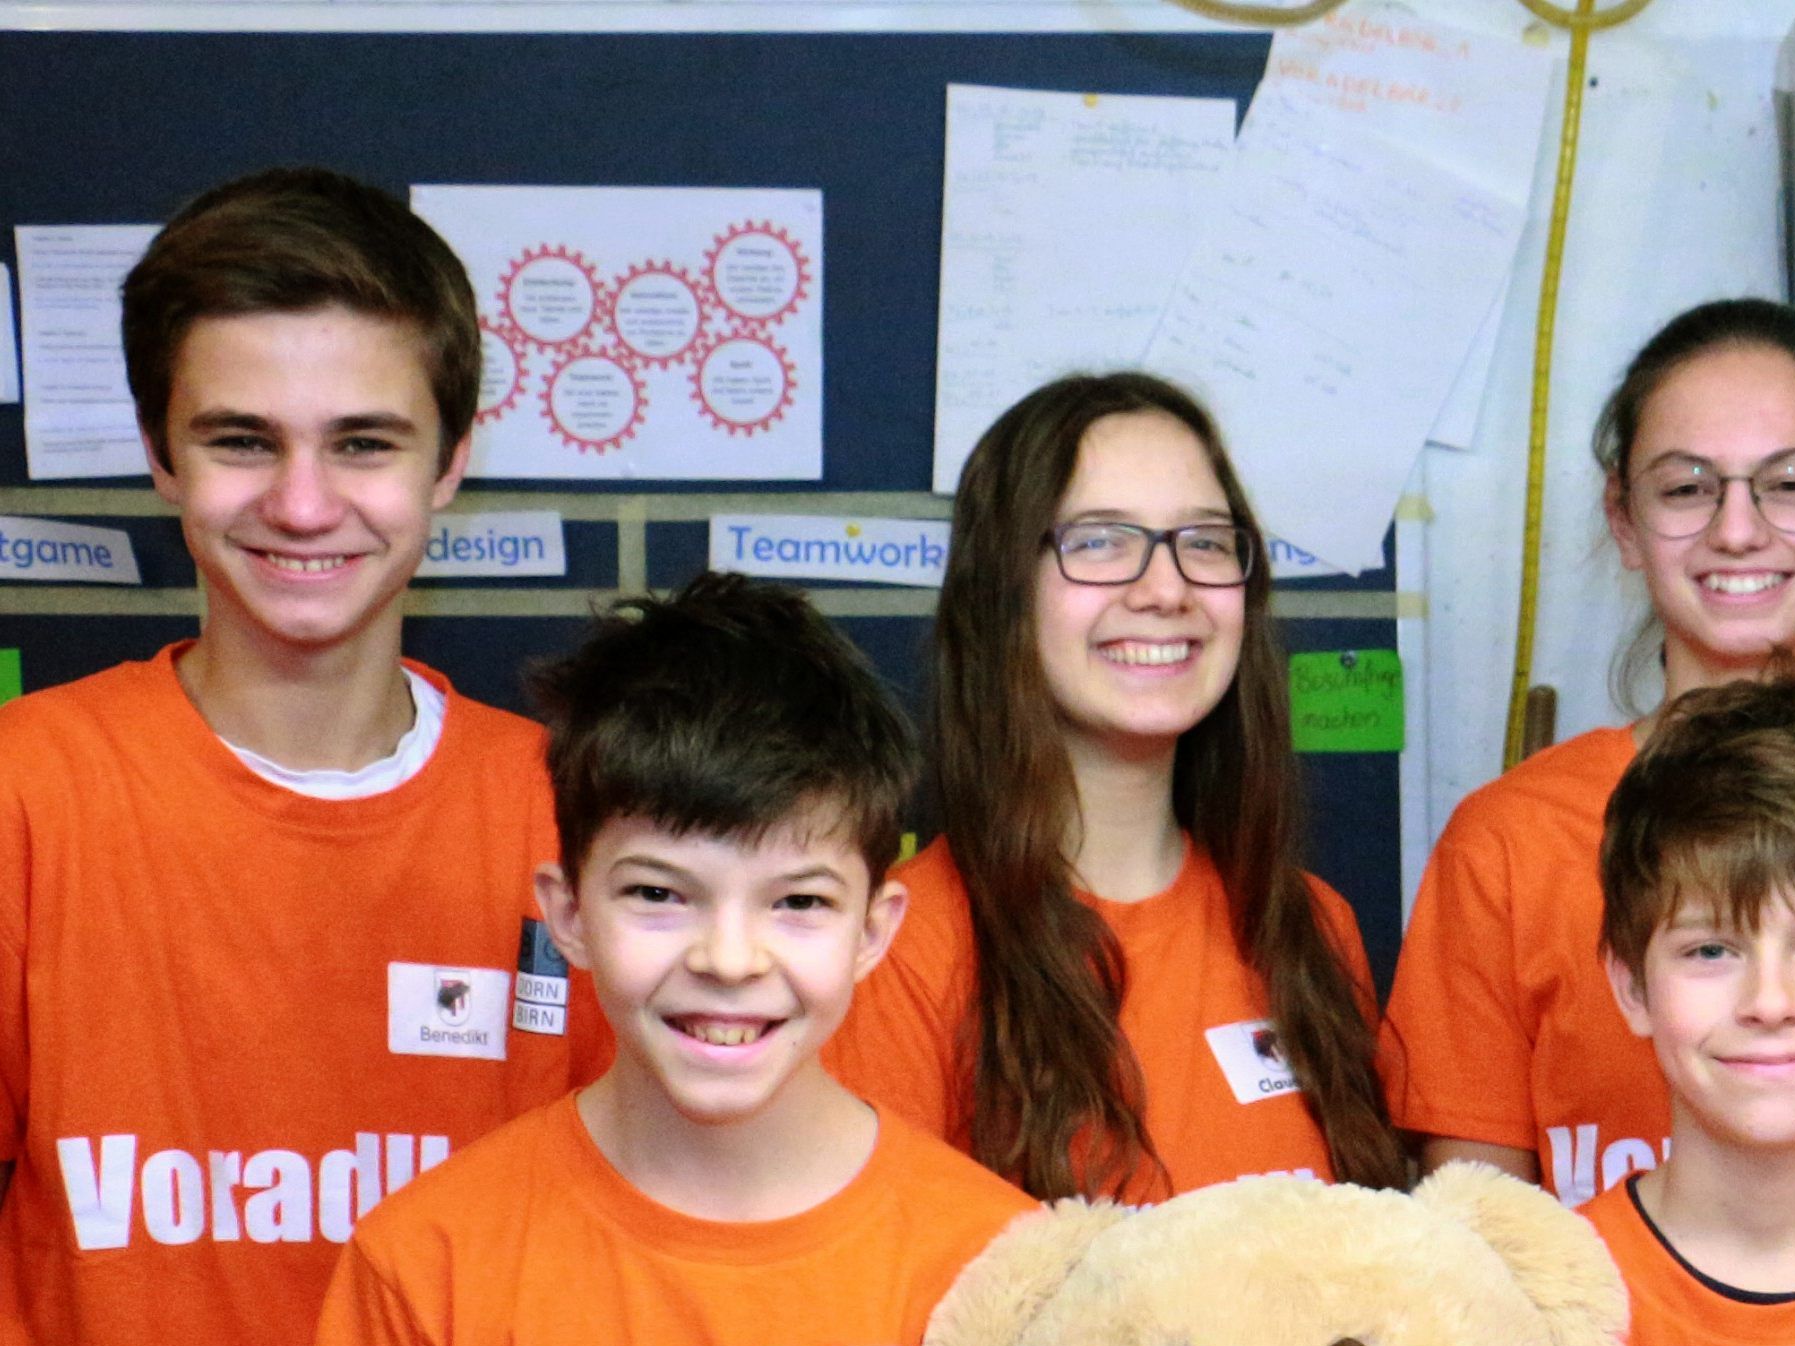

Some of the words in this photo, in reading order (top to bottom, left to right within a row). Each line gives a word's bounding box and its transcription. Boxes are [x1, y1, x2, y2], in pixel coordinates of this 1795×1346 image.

[426, 527, 544, 566] design
[728, 525, 946, 568] Teamwork
[515, 1005, 555, 1028] BIRN
[420, 1025, 488, 1045] Benedikt
